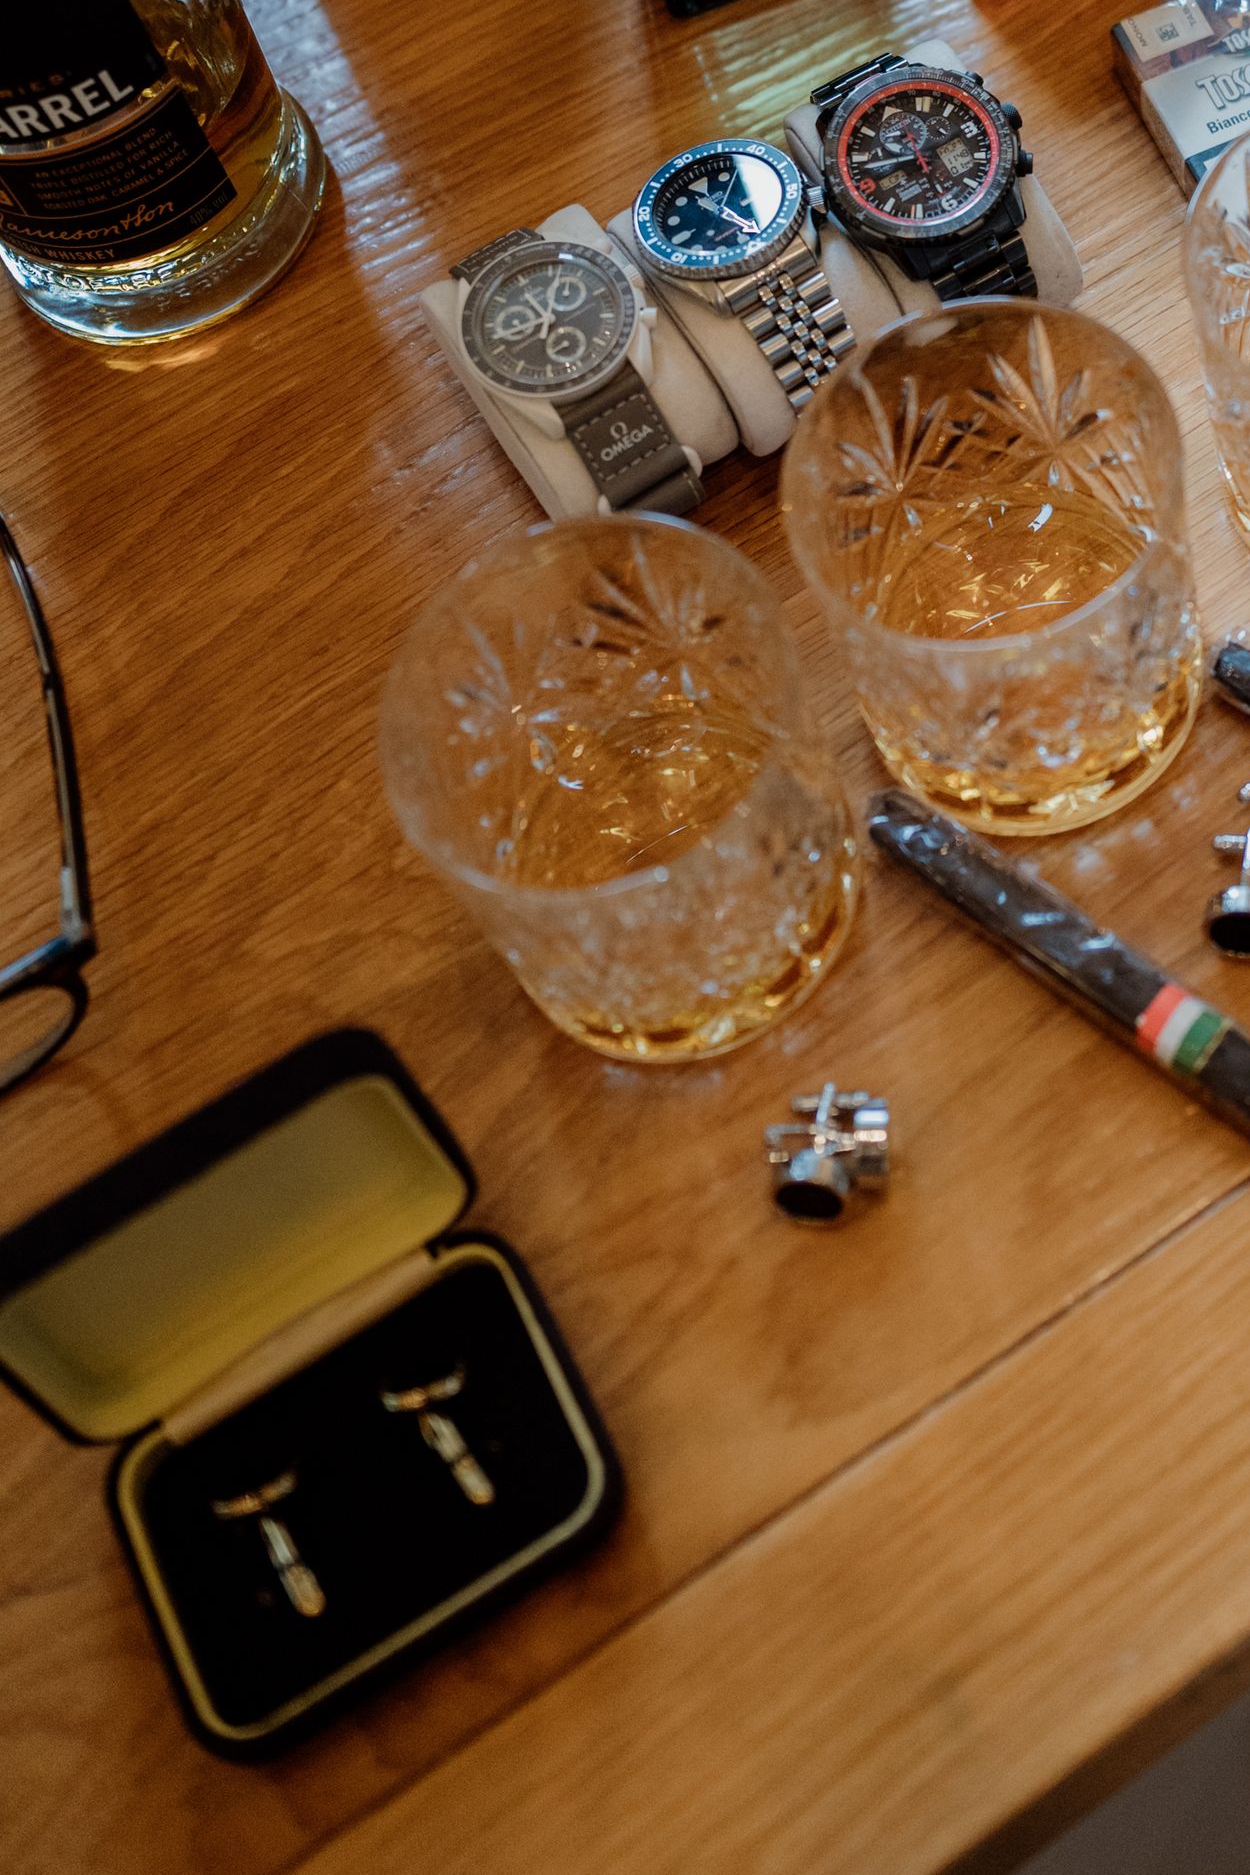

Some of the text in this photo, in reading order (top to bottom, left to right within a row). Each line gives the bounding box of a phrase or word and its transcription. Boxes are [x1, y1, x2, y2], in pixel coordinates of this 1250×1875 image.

[745, 143, 767, 156] 40
[672, 153, 694, 168] 30
[785, 183, 798, 200] 50
[638, 205, 651, 223] 20
[0, 213, 121, 242] ameson
[41, 246, 115, 262] WHISKEY
[669, 252, 689, 264] 10
[600, 424, 655, 462] OMEGA
